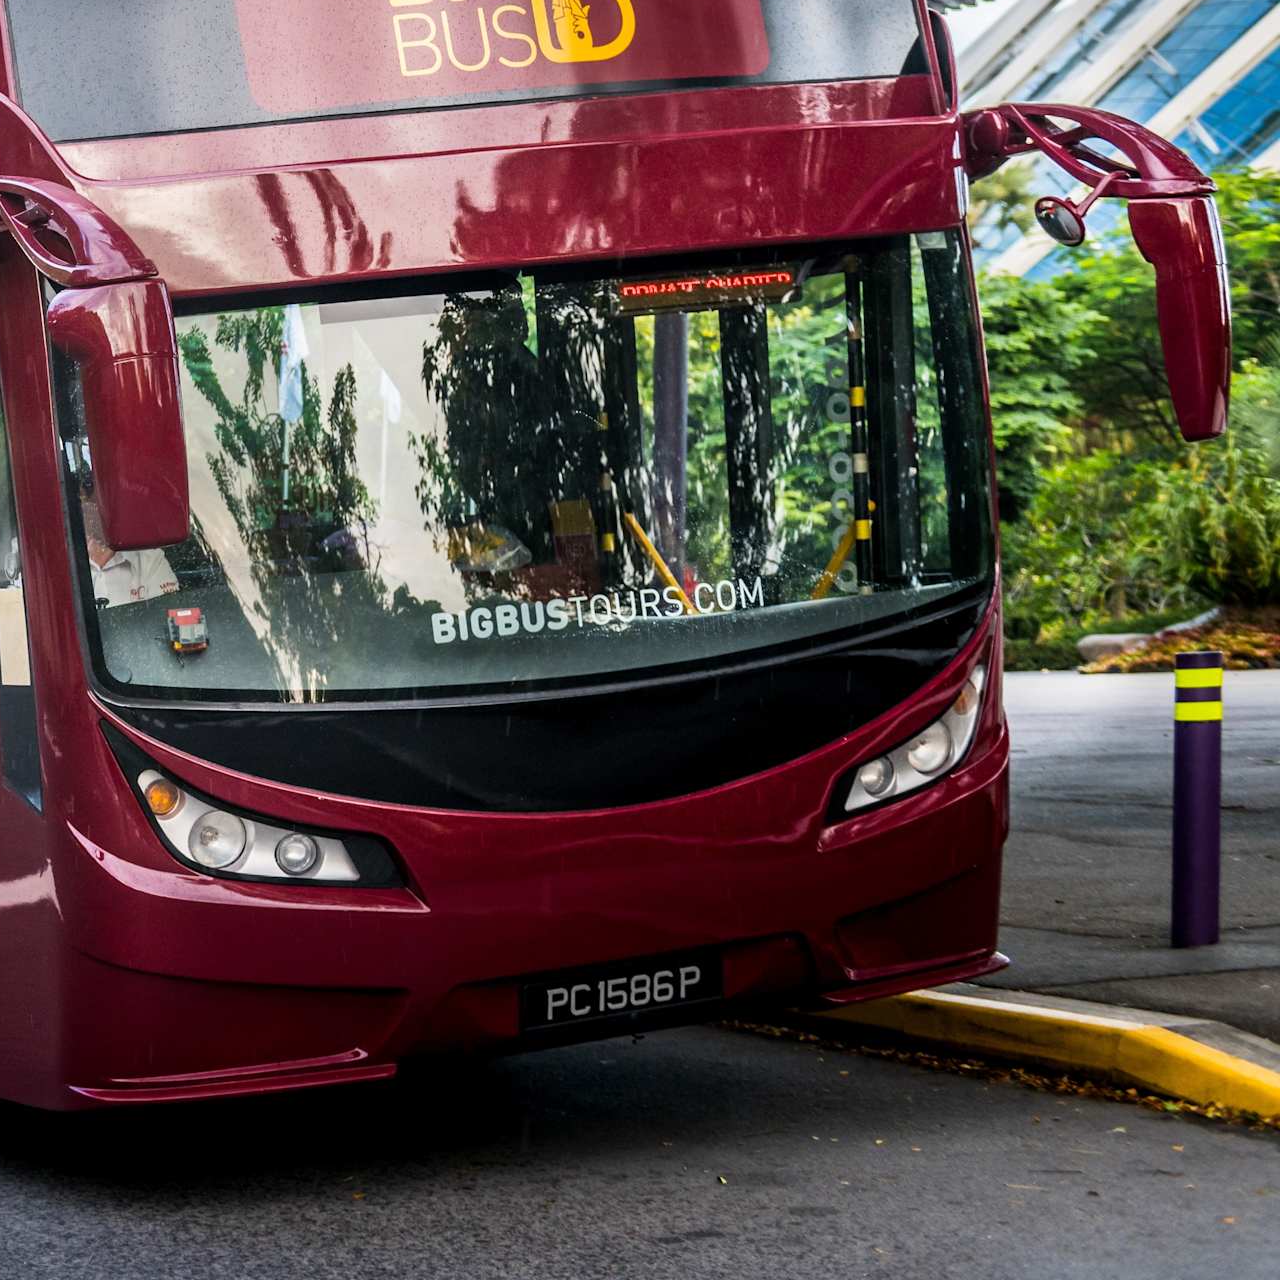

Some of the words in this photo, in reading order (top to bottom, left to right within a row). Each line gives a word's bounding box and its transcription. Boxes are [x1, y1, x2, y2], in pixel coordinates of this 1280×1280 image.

[393, 4, 538, 77] BUS
[431, 576, 765, 644] BIGBUSTOURS.COM
[546, 966, 701, 1020] PC1586P
